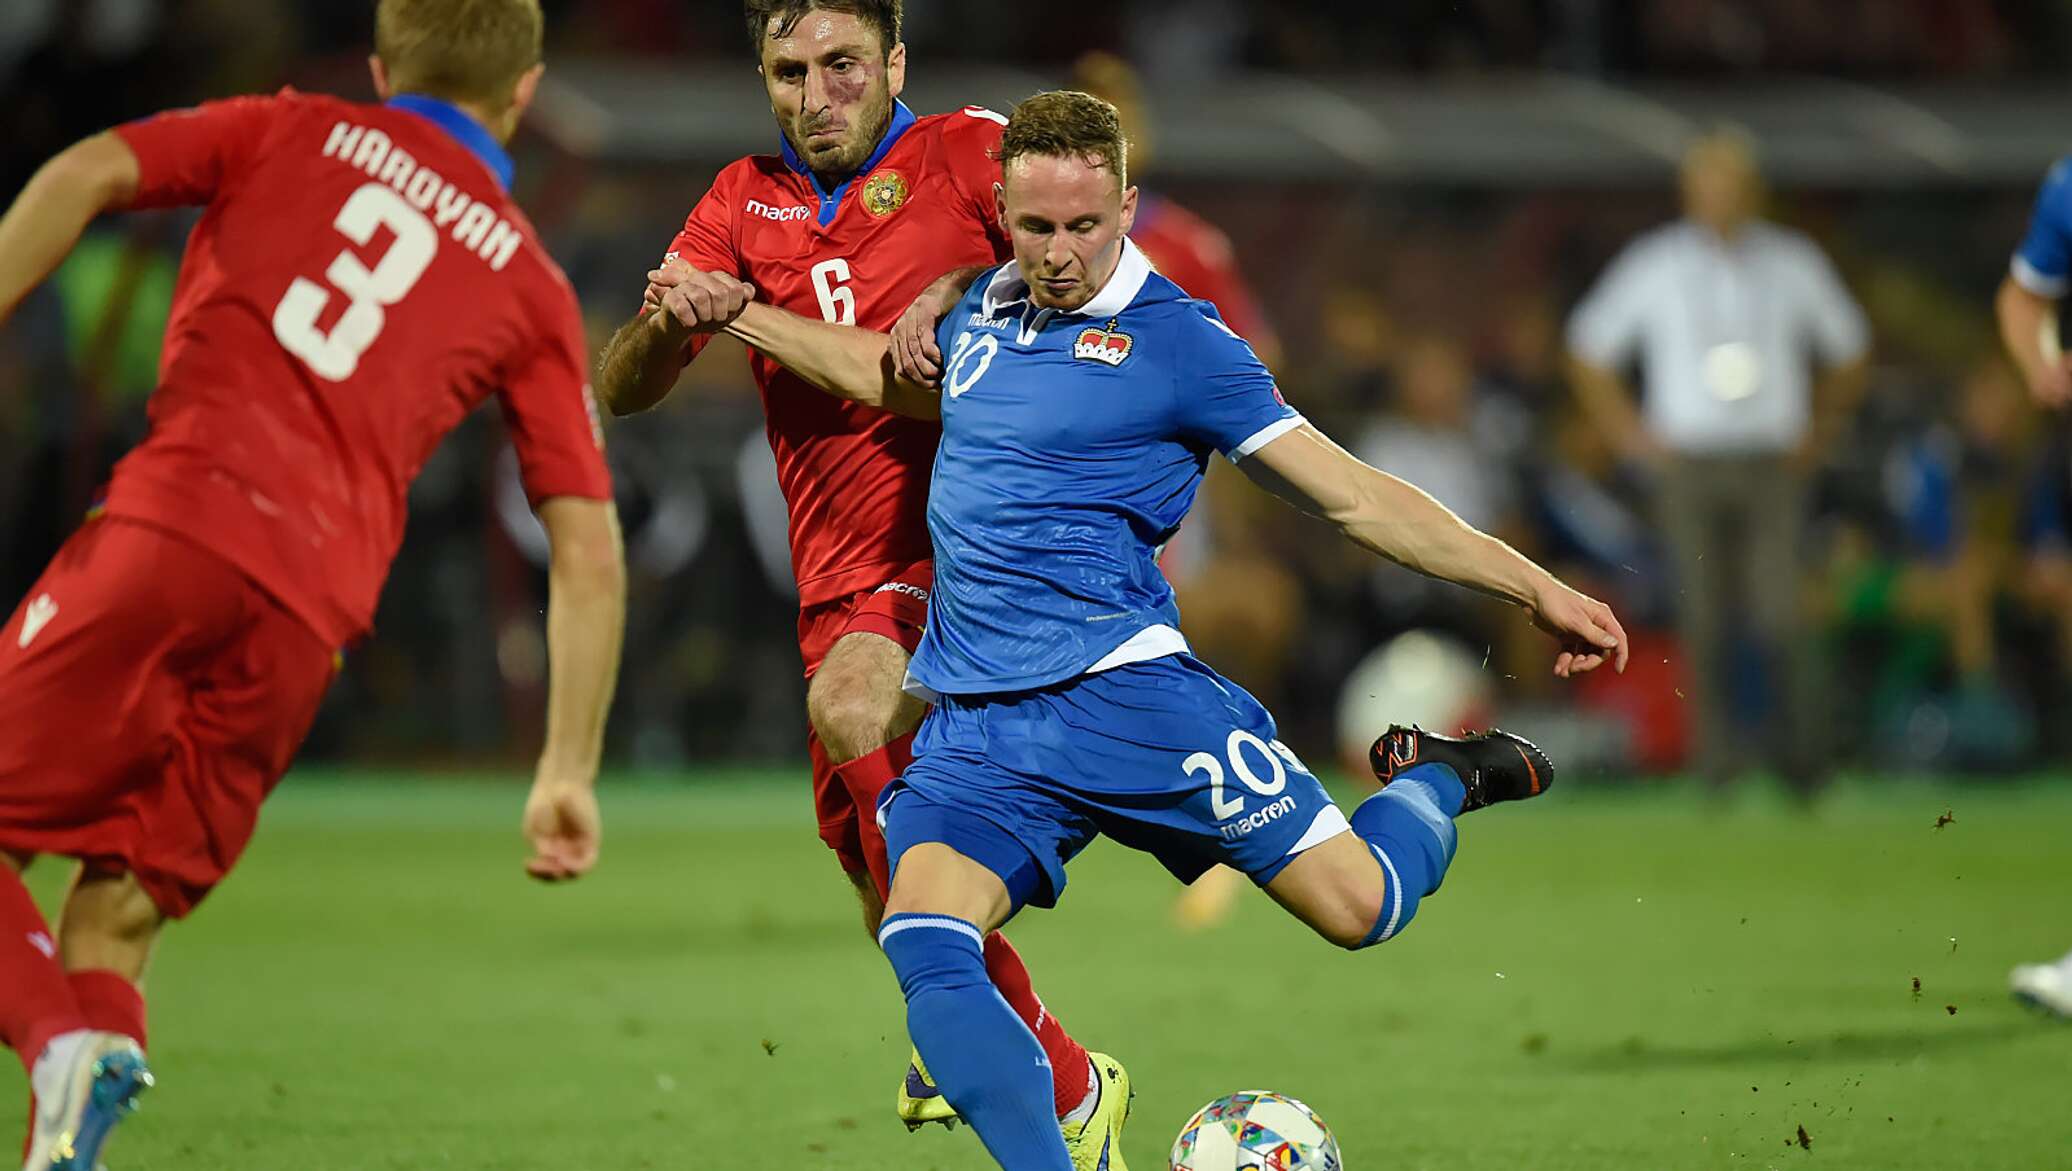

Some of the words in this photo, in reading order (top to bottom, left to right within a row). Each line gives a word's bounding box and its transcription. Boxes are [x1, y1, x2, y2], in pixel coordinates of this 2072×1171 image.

[322, 121, 522, 272] HAROYAN
[272, 182, 439, 382] 3
[811, 258, 856, 327] 6
[1181, 729, 1287, 821] 20
[1220, 795, 1297, 841] macron
